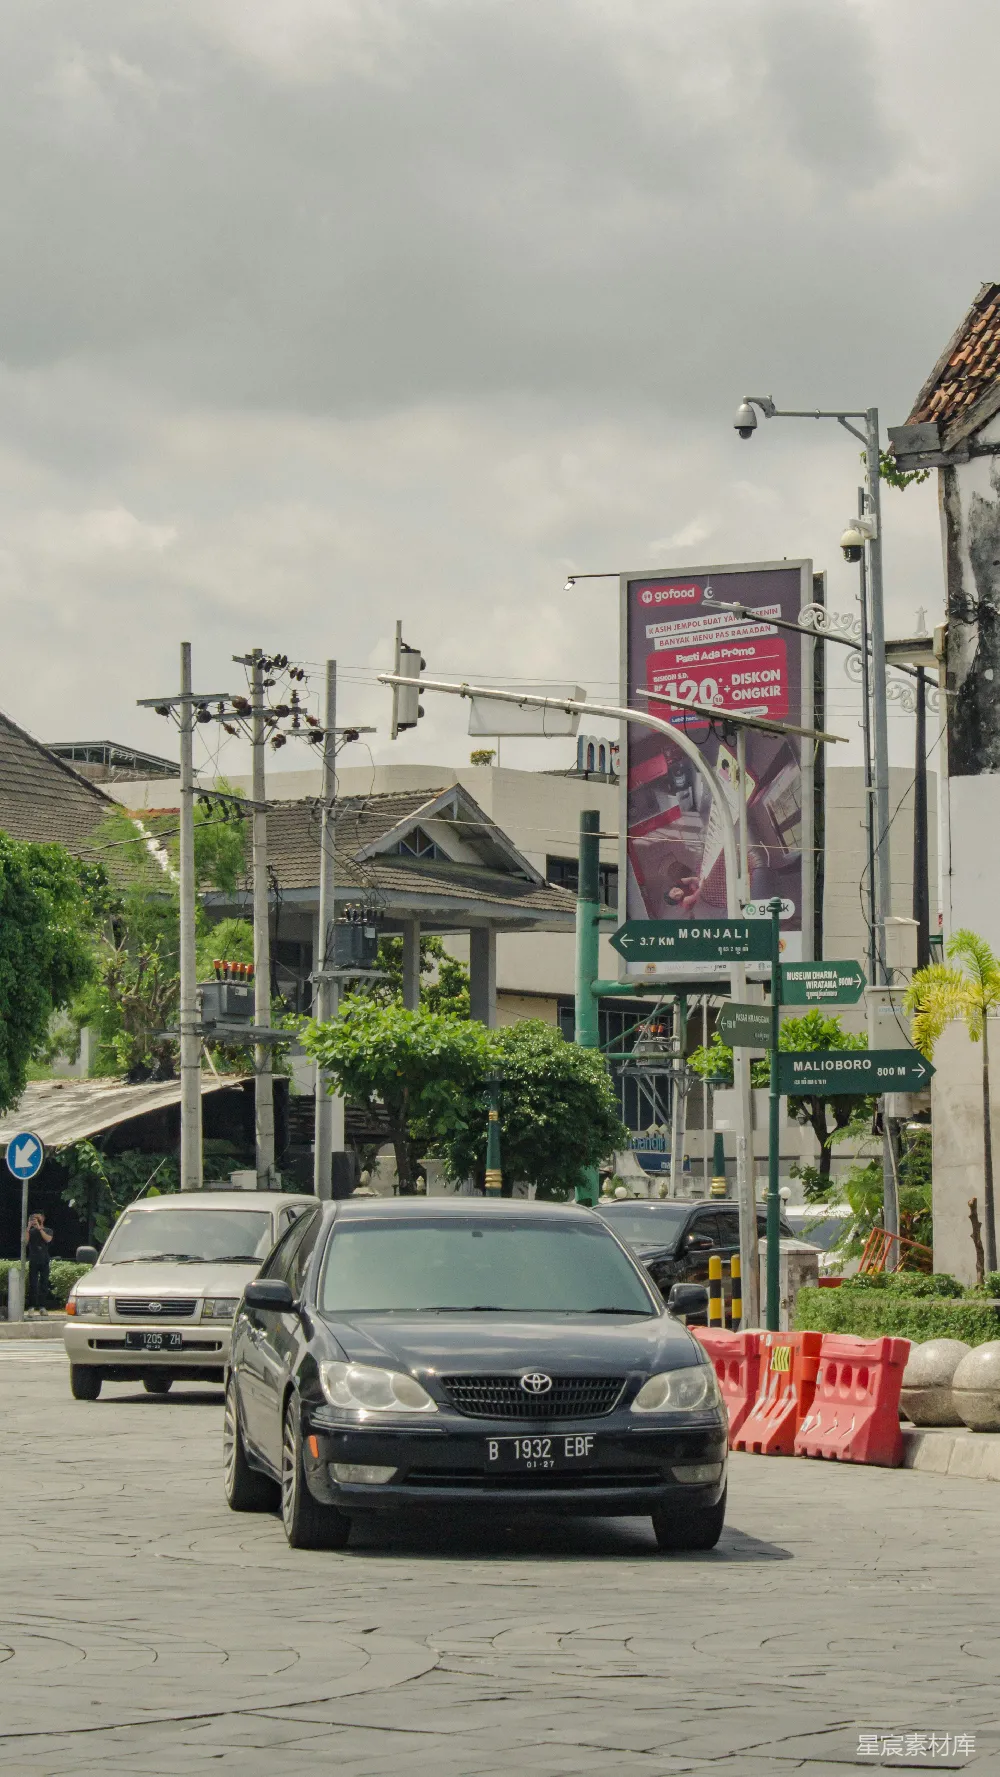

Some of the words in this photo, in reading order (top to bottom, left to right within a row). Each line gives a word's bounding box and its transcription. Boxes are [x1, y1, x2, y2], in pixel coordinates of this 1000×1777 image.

[654, 587, 695, 603] gofood
[649, 625, 672, 635] KASIH
[673, 621, 702, 631] JEMPOL
[703, 617, 721, 626] BUAT
[659, 634, 690, 647] BANYAK
[692, 632, 714, 643] MENU
[715, 631, 730, 640] PAS
[731, 624, 771, 637] RAMADAN
[675, 651, 700, 664] Pasti
[700, 650, 721, 660] Ada
[721, 646, 756, 658] Promo
[731, 669, 781, 686] DISKON
[678, 928, 749, 939] MONJALI
[639, 937, 655, 946] 3.7
[658, 937, 675, 946] KM
[786, 971, 812, 981] MUSEUM
[812, 970, 838, 979] DHARMA
[805, 980, 837, 989] WIRATAMA
[793, 1059, 872, 1072] MALIOBORO
[876, 1067, 895, 1076] 800
[897, 1066, 906, 1076] M
[126, 1332, 132, 1344] L
[143, 1333, 163, 1344] 1205
[170, 1333, 181, 1345] ZH
[489, 1441, 499, 1460] B
[514, 1438, 551, 1459] 1932
[564, 1436, 594, 1457] EBF
